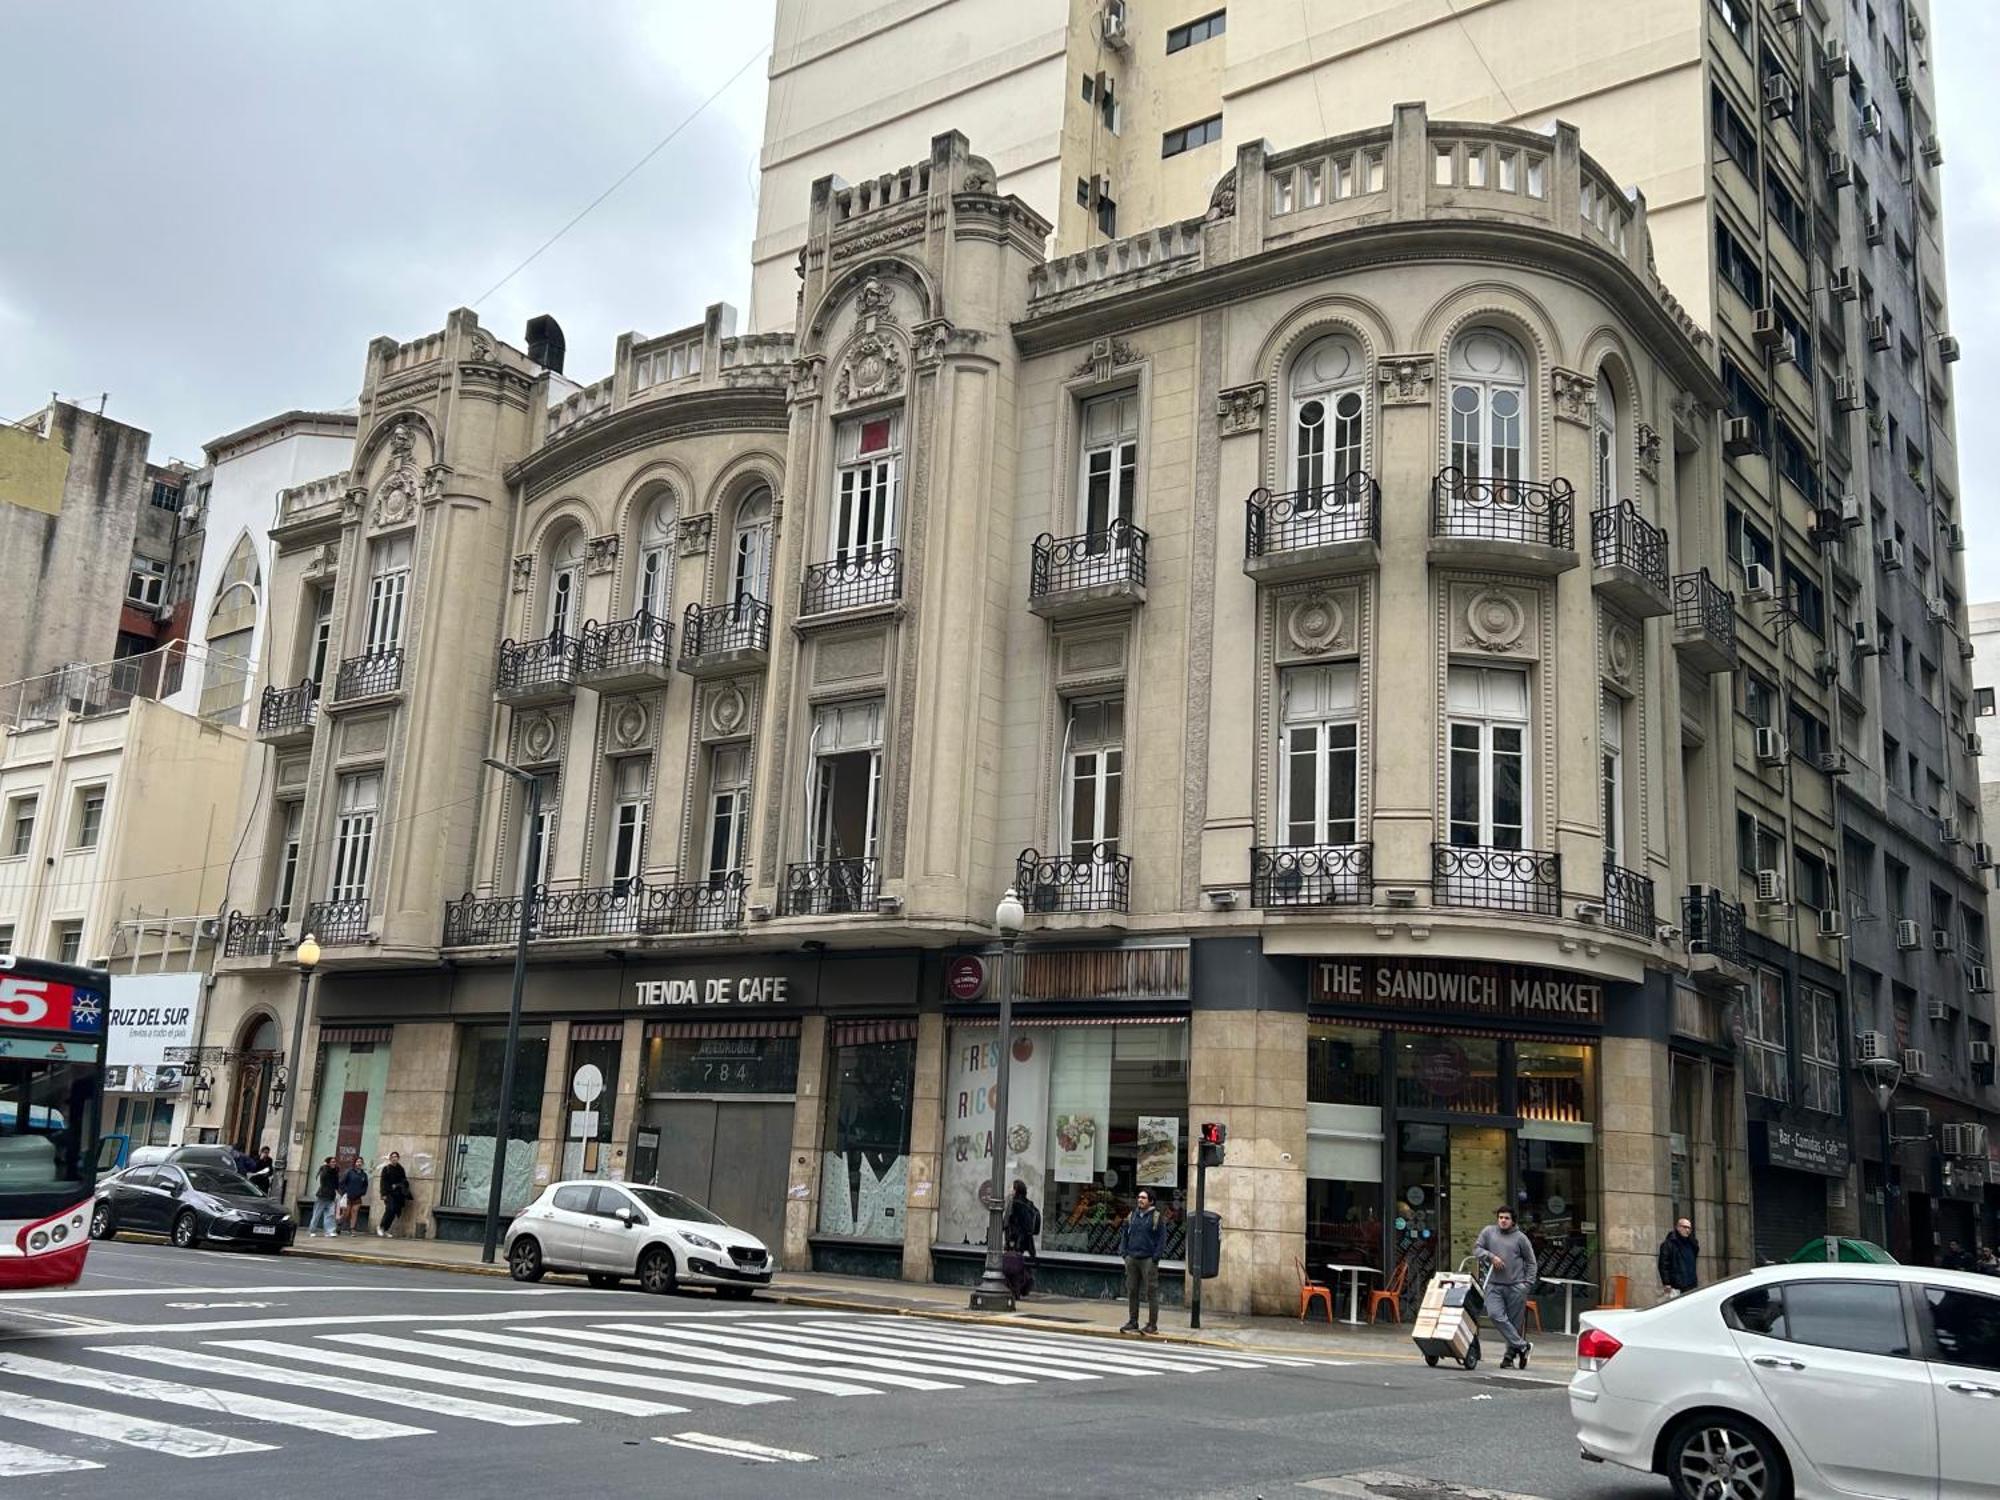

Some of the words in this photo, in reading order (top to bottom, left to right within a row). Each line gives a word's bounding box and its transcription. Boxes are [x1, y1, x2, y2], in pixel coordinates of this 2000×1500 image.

[0, 978, 48, 1023] 5
[635, 979, 699, 1005] TIENDA
[704, 978, 732, 1004] DE
[738, 976, 788, 1003] CAFE
[1320, 963, 1362, 994] THE
[1376, 967, 1497, 1005] SANDWICH
[1510, 979, 1600, 1013] MARKET
[137, 1008, 160, 1026] DEL
[162, 1007, 189, 1026] SUR
[960, 1040, 999, 1073] FRES
[704, 1063, 747, 1081] 784
[974, 1130, 993, 1160] SA
[1779, 1128, 1790, 1145] Bar
